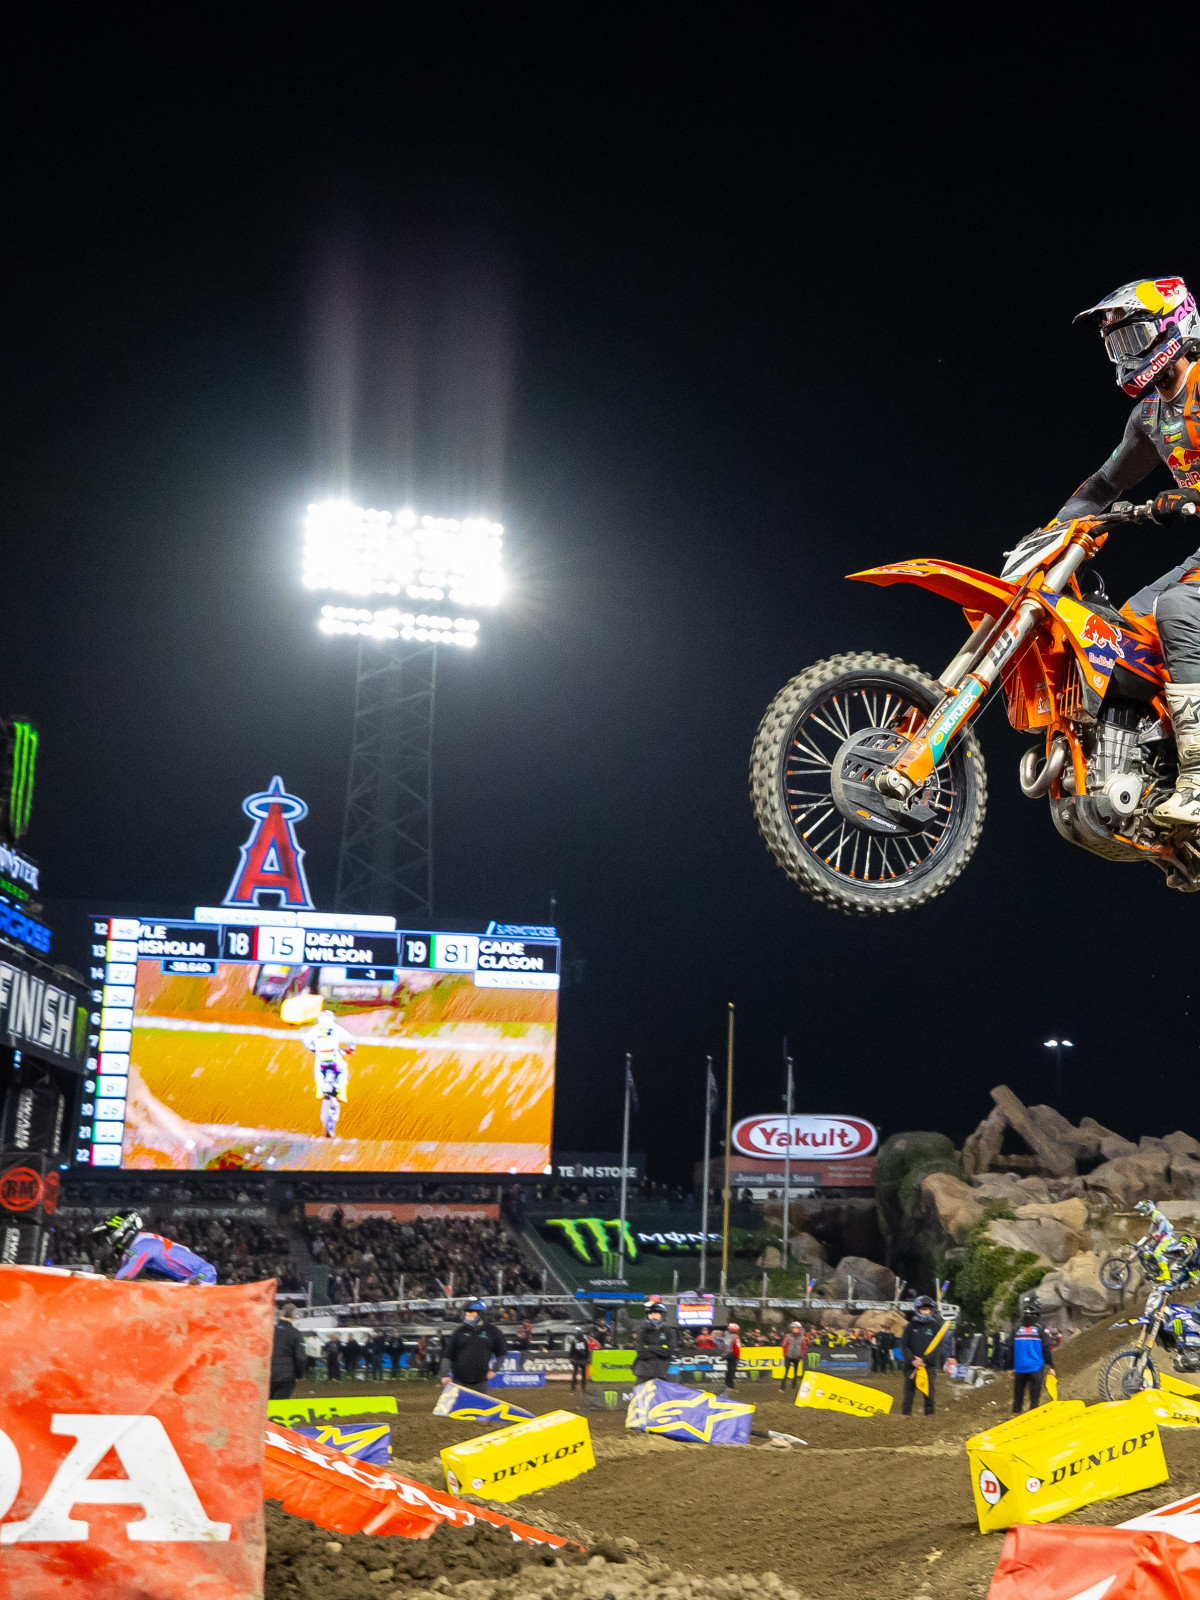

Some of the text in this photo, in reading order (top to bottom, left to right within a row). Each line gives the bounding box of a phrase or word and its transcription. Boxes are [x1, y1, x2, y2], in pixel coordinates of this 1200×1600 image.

[942, 693, 977, 735] MOTOREX
[94, 922, 108, 936] 12
[228, 932, 294, 957] 18 15
[306, 932, 354, 948] DEAN
[479, 940, 525, 956] CADE
[305, 947, 373, 963] WILSON
[406, 940, 468, 963] 19 81
[478, 954, 544, 971] CLASON
[758, 1127, 853, 1148] Yakult
[491, 1440, 585, 1483] DUNLOP
[1050, 1430, 1155, 1485] DUNLOP
[984, 1479, 998, 1495] D
